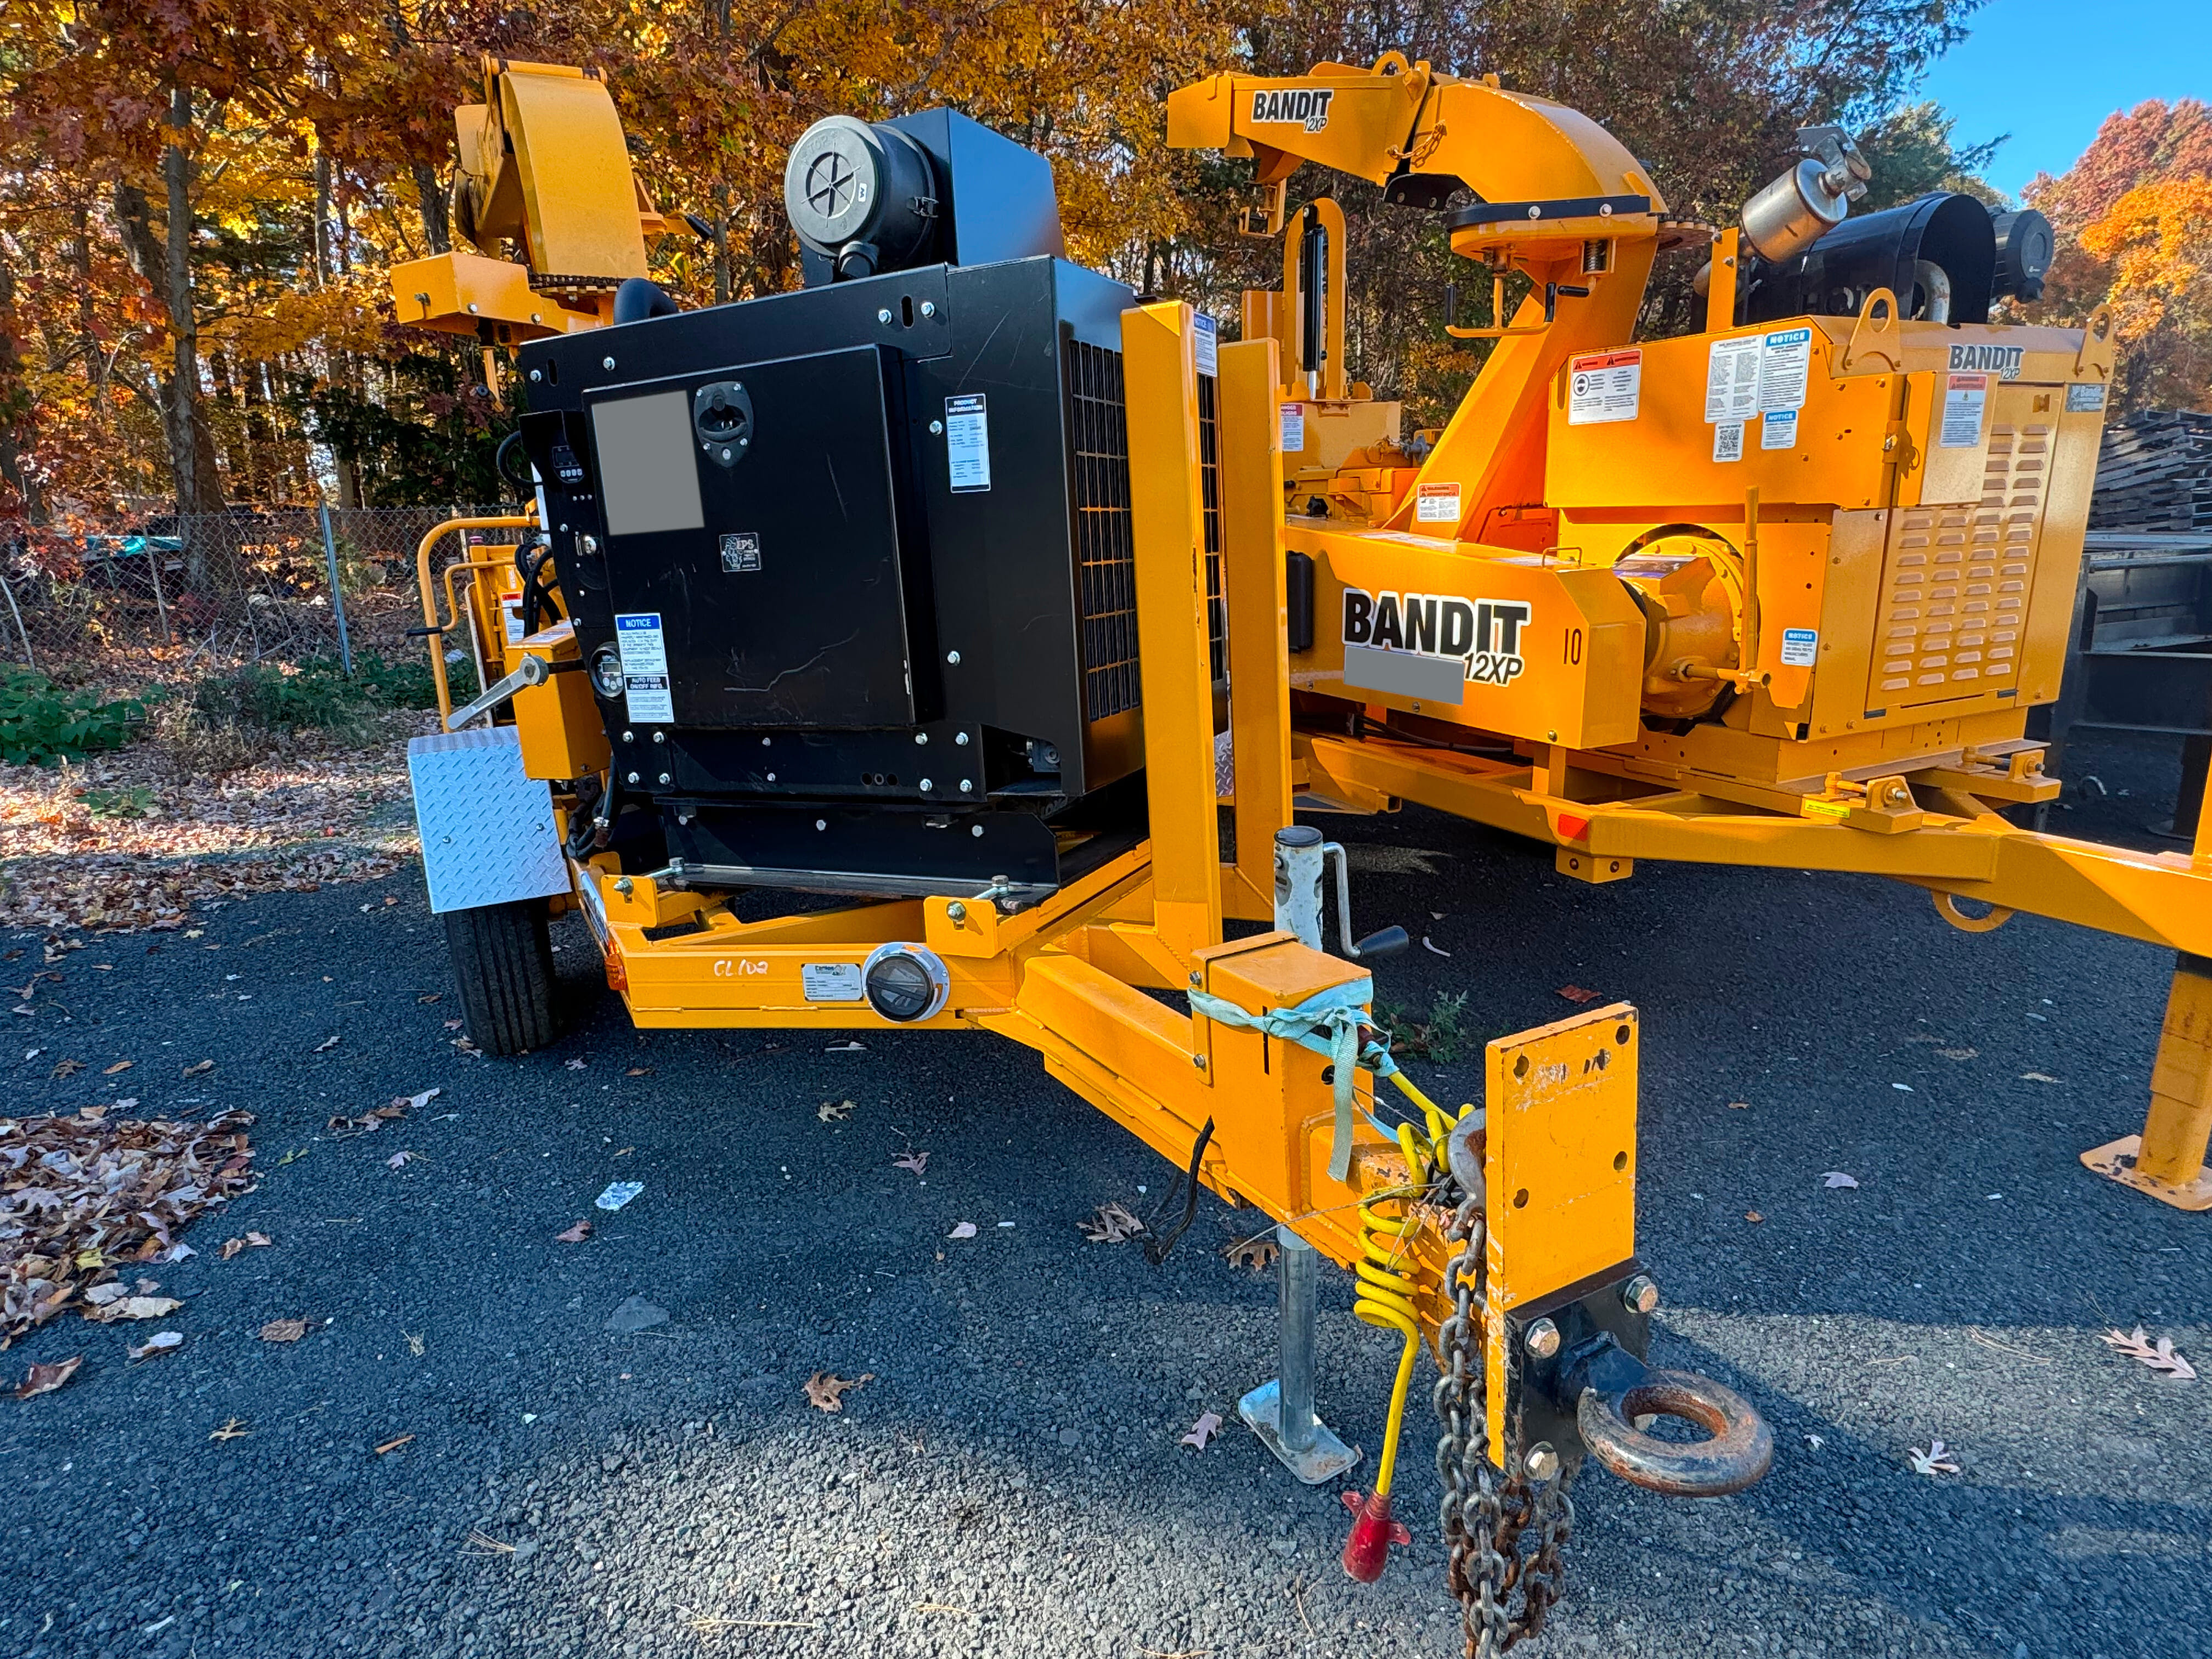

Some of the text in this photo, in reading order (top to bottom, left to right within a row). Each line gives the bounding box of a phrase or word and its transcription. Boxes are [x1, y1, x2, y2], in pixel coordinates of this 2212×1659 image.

[1252, 91, 1333, 120] BANDIT
[1304, 117, 1328, 132] 12XP
[1770, 331, 1806, 345] NOTICE
[1949, 345, 2024, 370] BANDIT
[2000, 368, 2021, 380] 12XP
[625, 618, 652, 628] NOTICE
[1344, 592, 1528, 657] BANDIT
[1563, 628, 1583, 665] 10
[1464, 652, 1523, 685] 12XP
